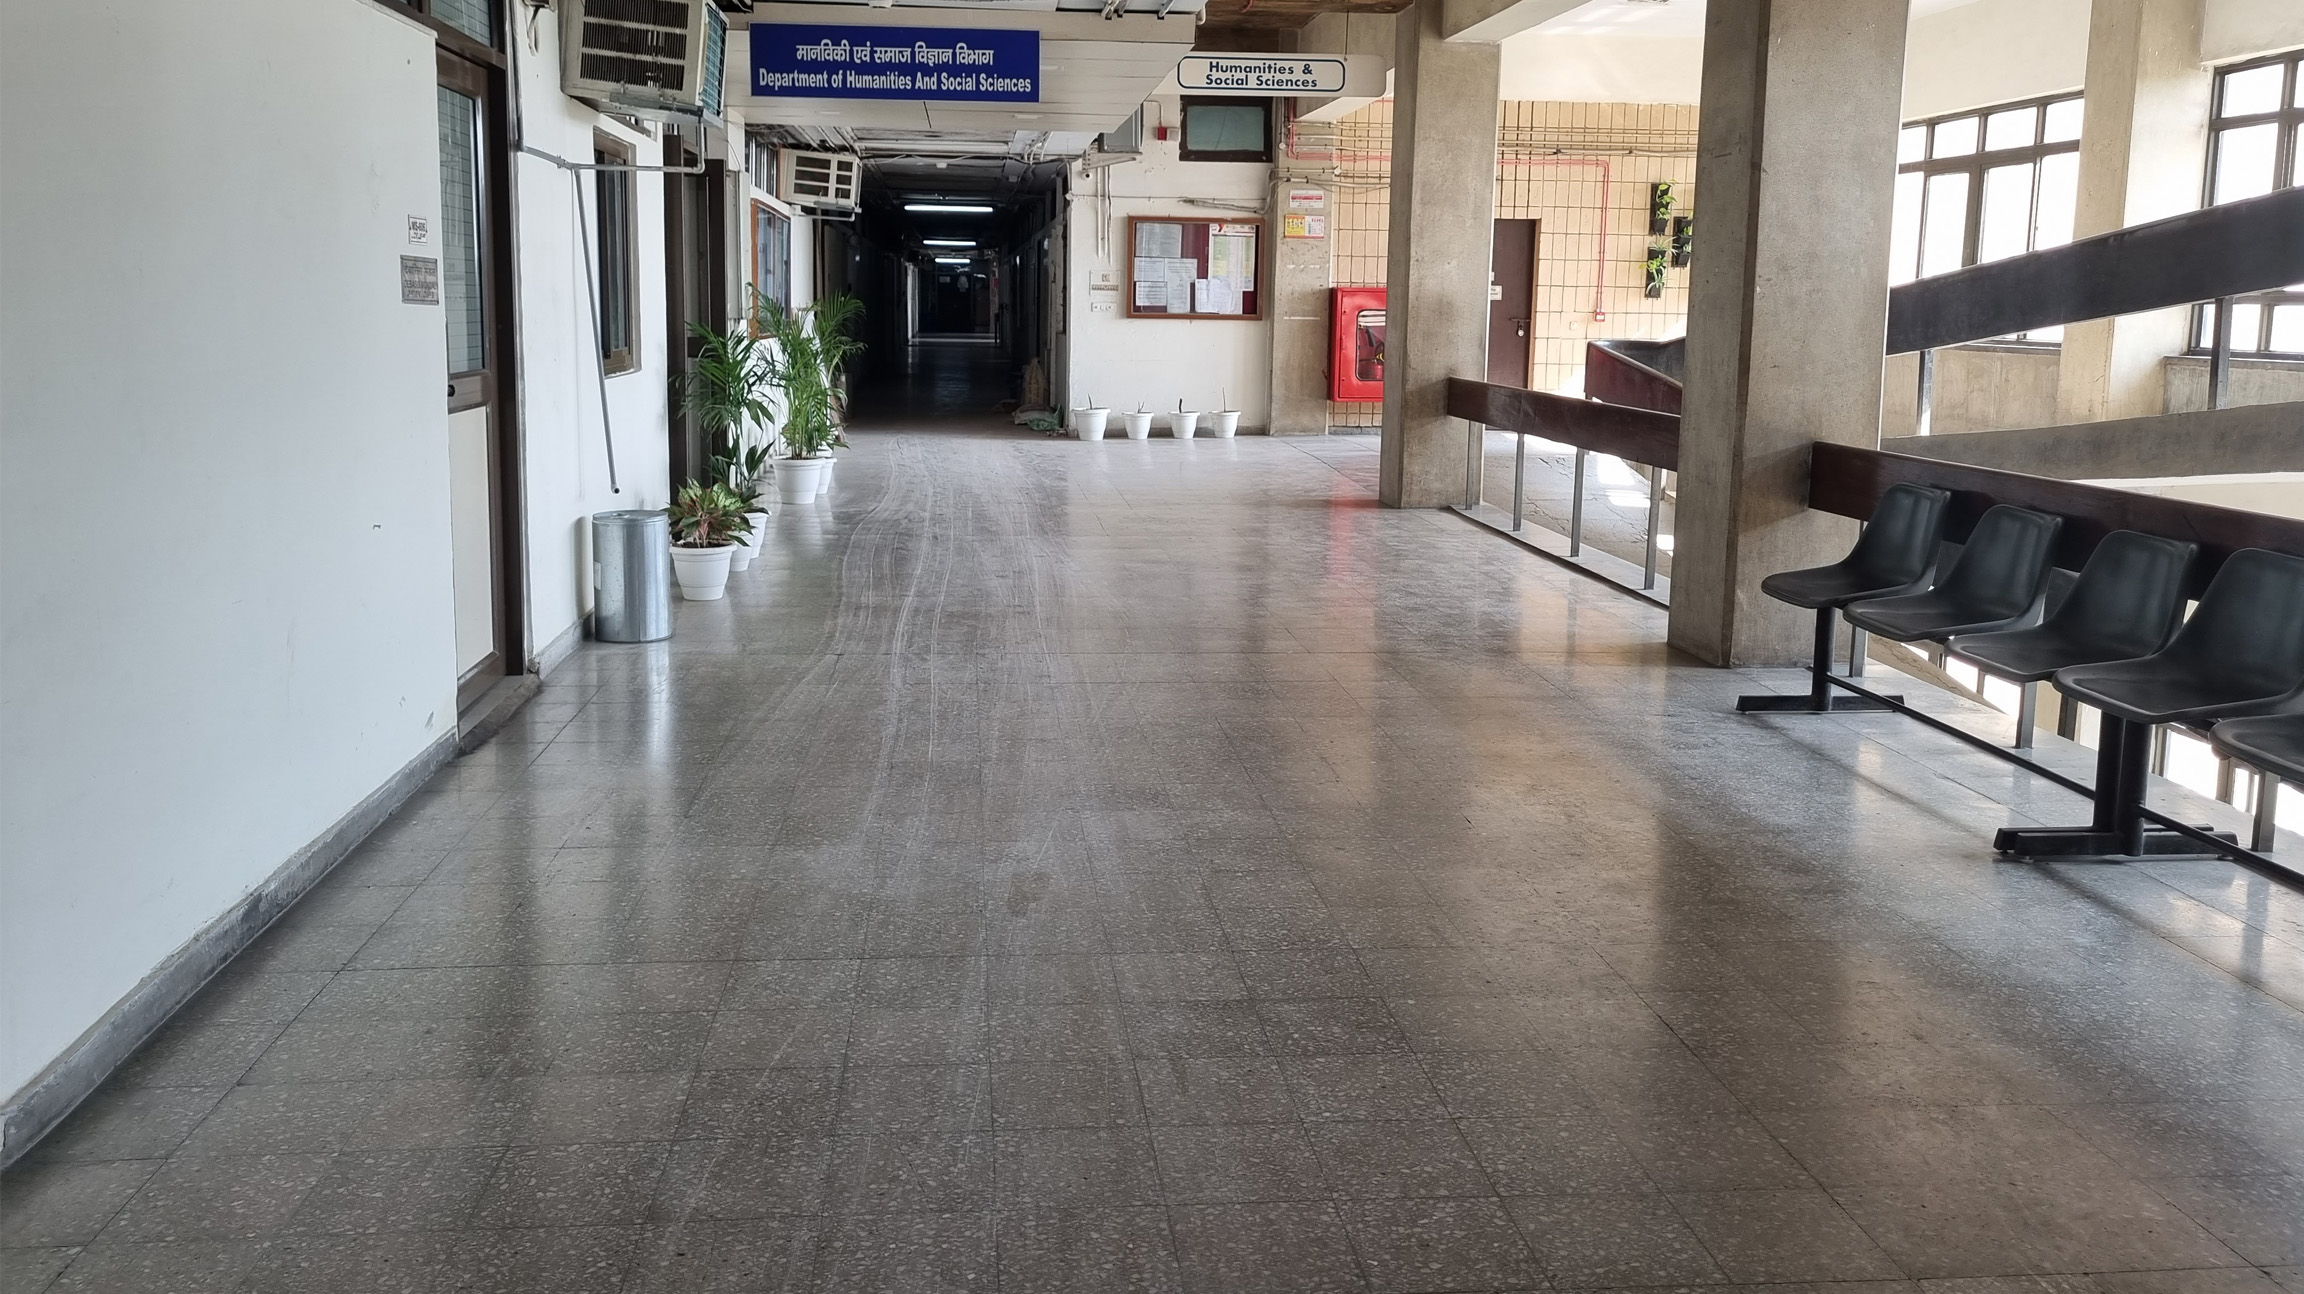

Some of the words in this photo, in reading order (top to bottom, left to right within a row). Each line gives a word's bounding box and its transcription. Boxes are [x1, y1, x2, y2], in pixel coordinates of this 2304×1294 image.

[796, 39, 850, 62] मानविकी
[853, 41, 871, 63] एवं
[873, 47, 911, 63] समाज
[914, 41, 953, 66] विज्ञान
[955, 42, 994, 65] विभाग
[1208, 60, 1294, 75] Humanities
[1302, 63, 1313, 75] &
[759, 67, 828, 91] Department
[831, 70, 843, 88] of
[846, 70, 912, 90] Humanities
[915, 72, 937, 90] And
[941, 72, 976, 91] Social
[980, 73, 1032, 92] Sciences
[1205, 74, 1249, 86] Social
[1255, 75, 1318, 88] Sciences
